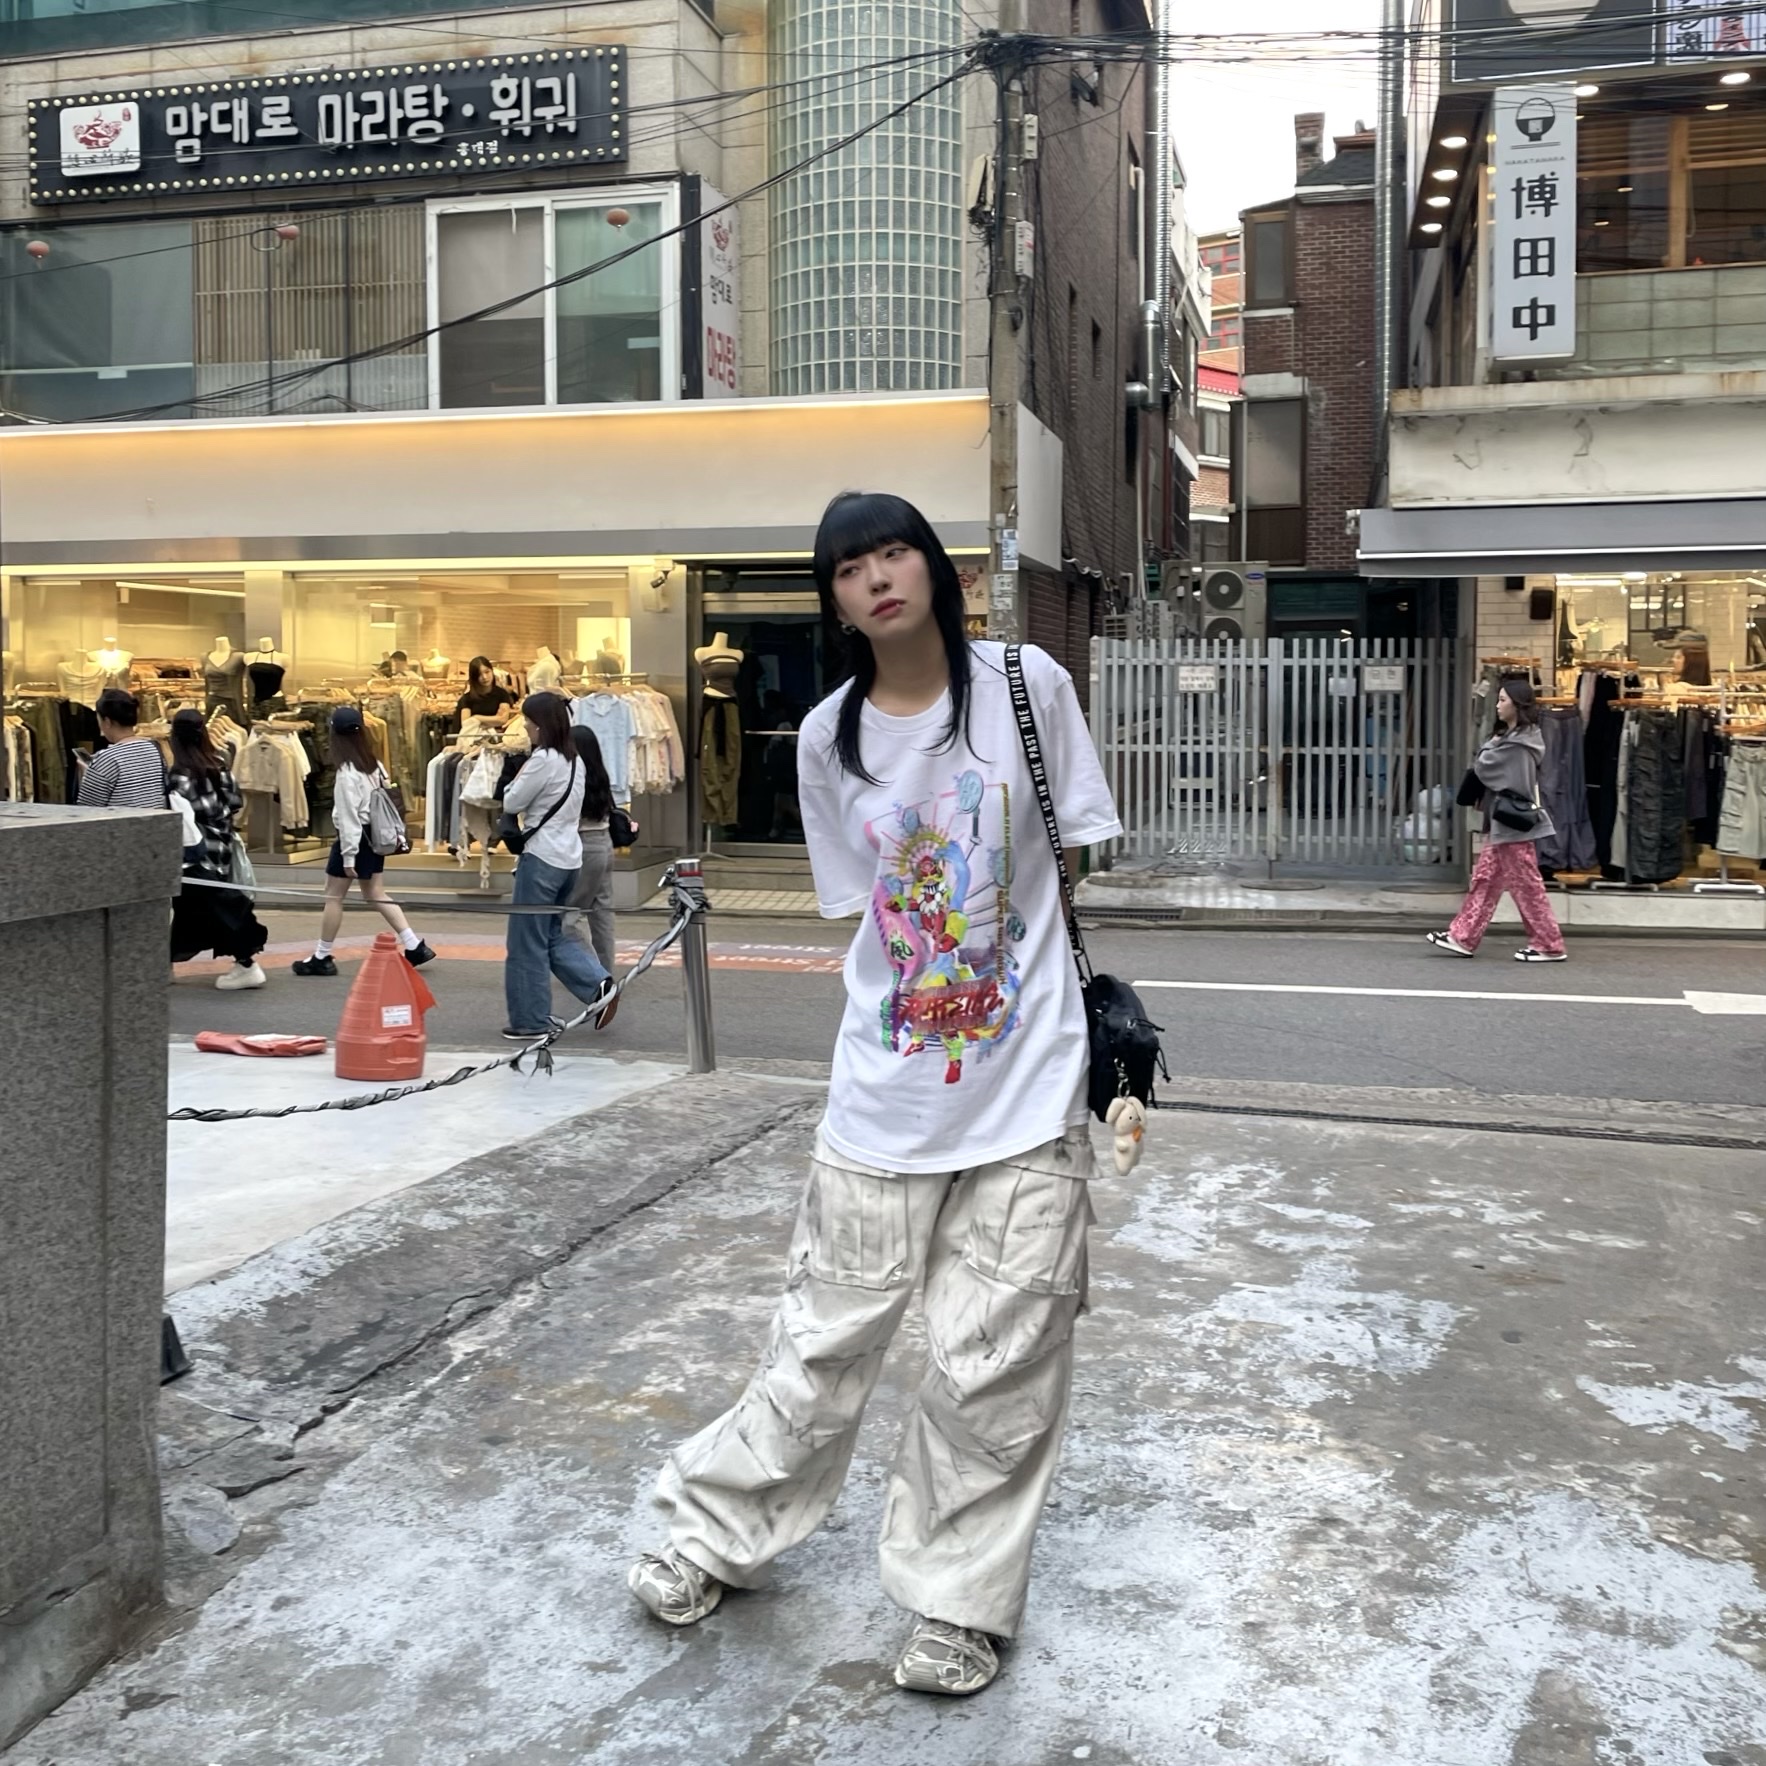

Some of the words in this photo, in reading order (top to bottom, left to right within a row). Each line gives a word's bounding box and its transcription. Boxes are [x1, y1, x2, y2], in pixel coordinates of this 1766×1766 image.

[165, 96, 299, 163] 맘대로
[318, 83, 449, 149] 마라탕
[1510, 171, 1560, 341] 博田中
[1006, 651, 1019, 661] IS
[1008, 665, 1027, 706] FUTURE
[1017, 708, 1033, 730] THE
[1024, 734, 1040, 760] PAST
[1031, 761, 1045, 783] THE
[1037, 785, 1048, 797] IN
[1041, 800, 1051, 811] IS
[1045, 815, 1062, 854] FUTURE
